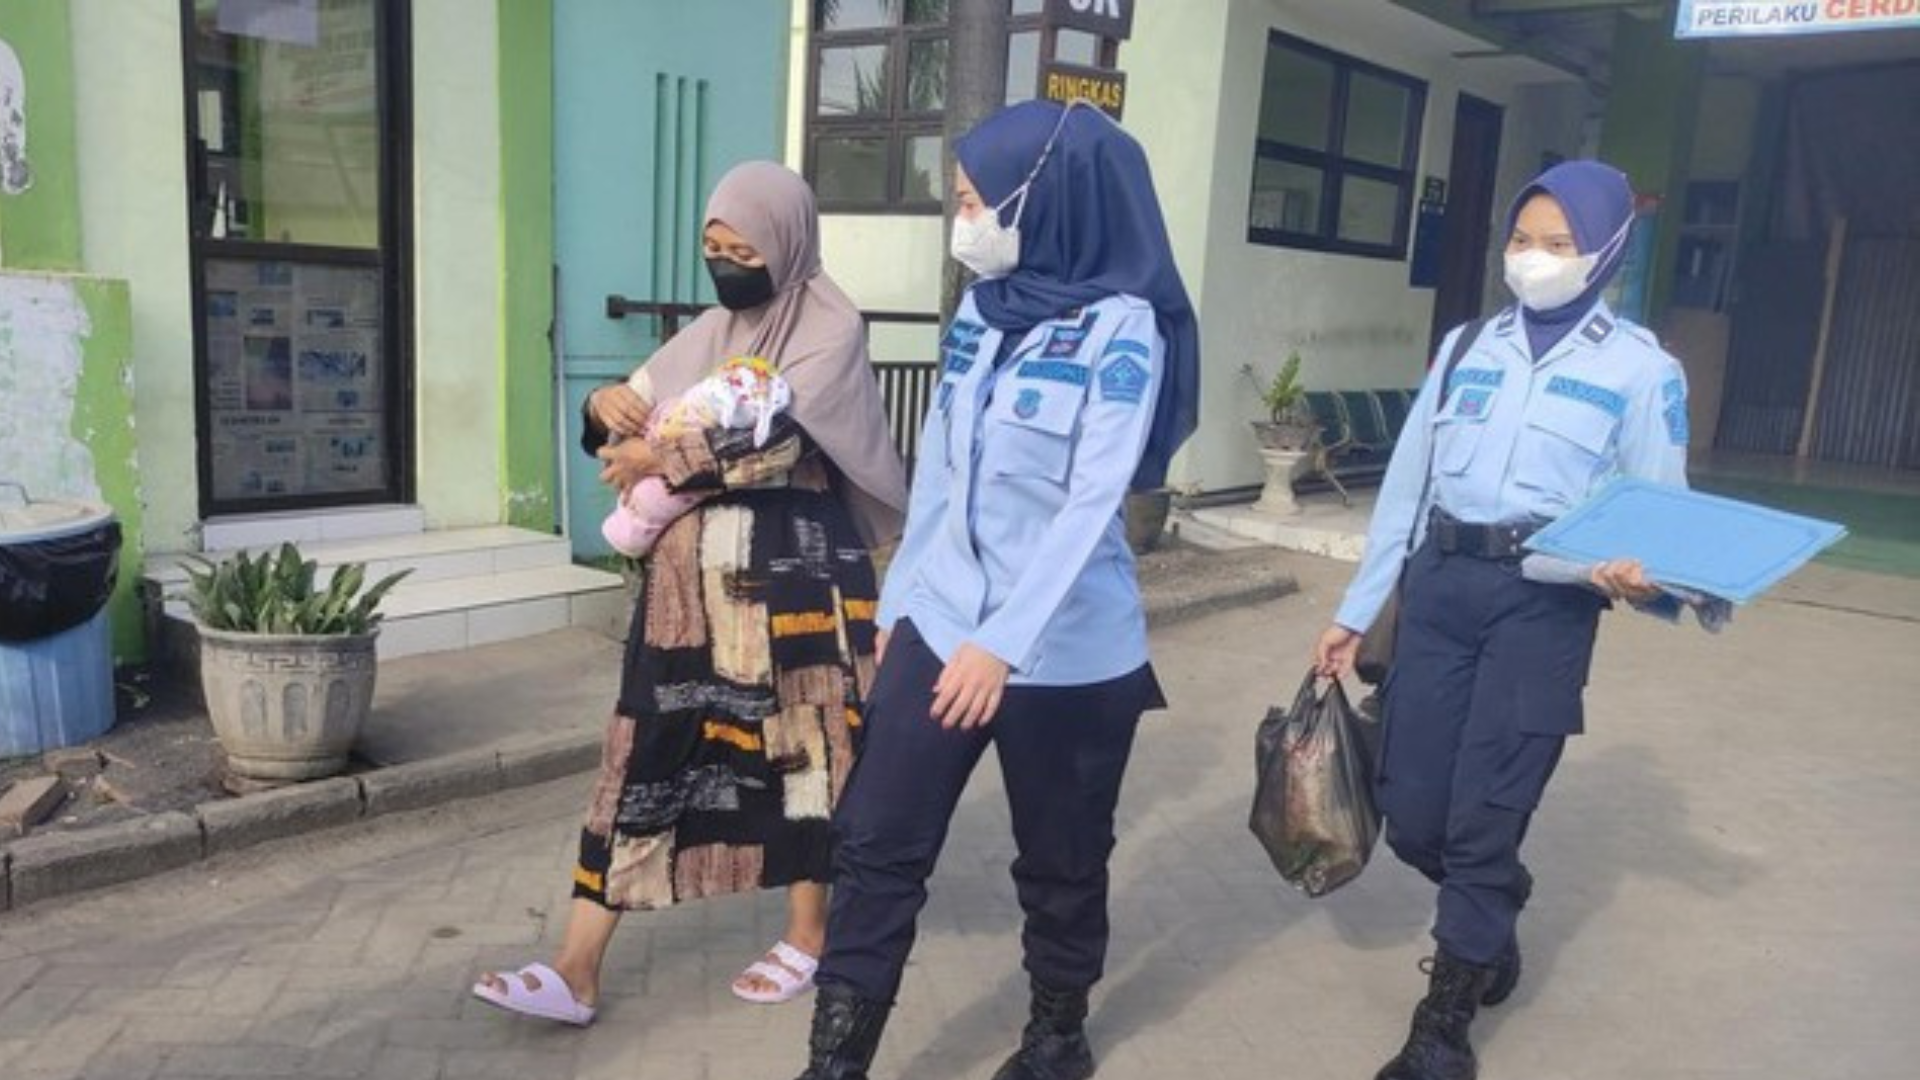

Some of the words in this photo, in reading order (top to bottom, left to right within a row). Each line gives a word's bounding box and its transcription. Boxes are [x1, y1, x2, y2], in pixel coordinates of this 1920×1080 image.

[1698, 4, 1818, 26] PERILAKU
[1825, 0, 1920, 19] CERD
[1047, 71, 1123, 107] RINGKAS
